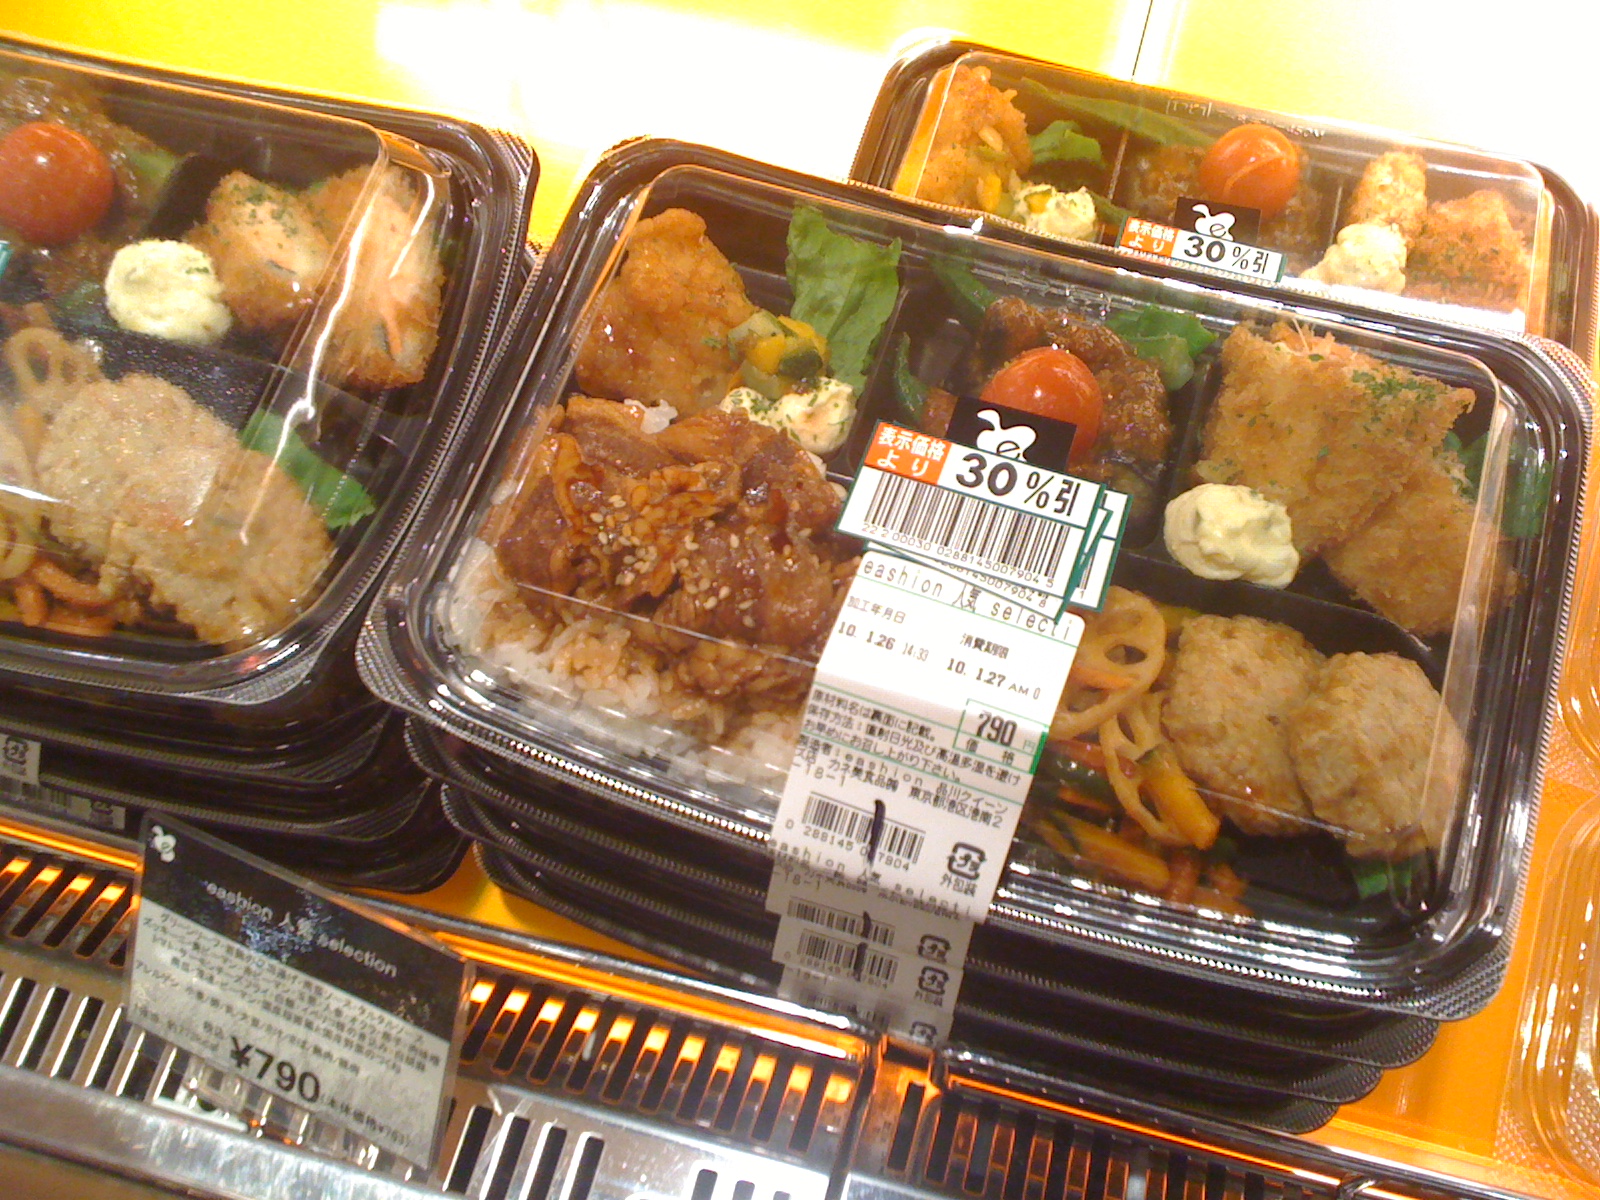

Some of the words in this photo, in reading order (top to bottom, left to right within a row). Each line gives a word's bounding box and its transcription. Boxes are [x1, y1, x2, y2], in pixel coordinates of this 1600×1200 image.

[1128, 219, 1175, 241] 表示価格
[1128, 237, 1165, 253] より
[877, 426, 948, 461] 表示価格
[877, 450, 930, 477] より
[863, 560, 944, 599] eashion
[847, 596, 907, 624] 加工年月日
[959, 632, 1010, 660] 消費期限
[976, 710, 1019, 747] 790
[938, 872, 980, 899] 外包装
[228, 1034, 321, 1104] ¥790
